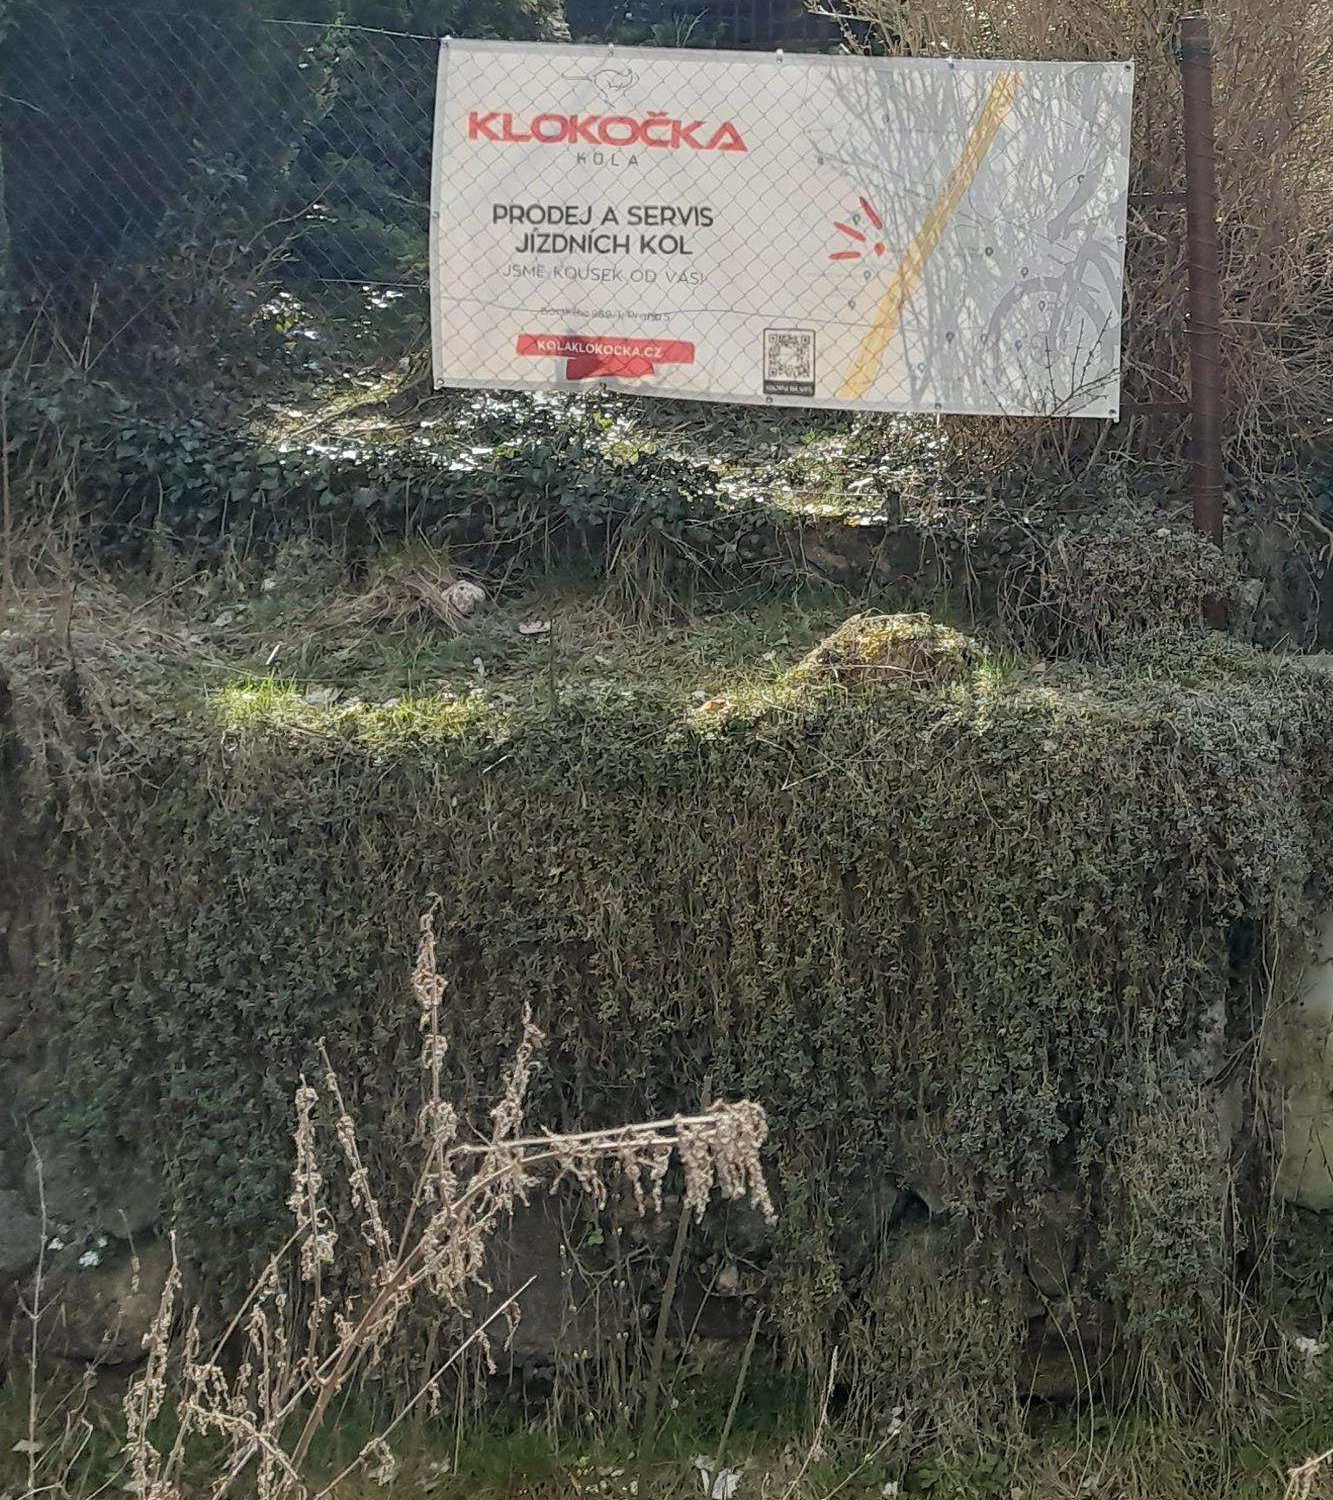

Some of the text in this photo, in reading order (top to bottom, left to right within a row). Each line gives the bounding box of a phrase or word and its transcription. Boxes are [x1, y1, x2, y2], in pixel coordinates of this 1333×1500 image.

[468, 110, 749, 152] KLOKOČKA
[576, 152, 639, 167] KOLA
[492, 203, 714, 228] PRODEJ A SERVIS
[515, 228, 693, 255] JÍZDNÍCH KOL
[502, 264, 547, 279] JSME
[553, 265, 624, 282] KOUSEK
[630, 269, 658, 284] OD
